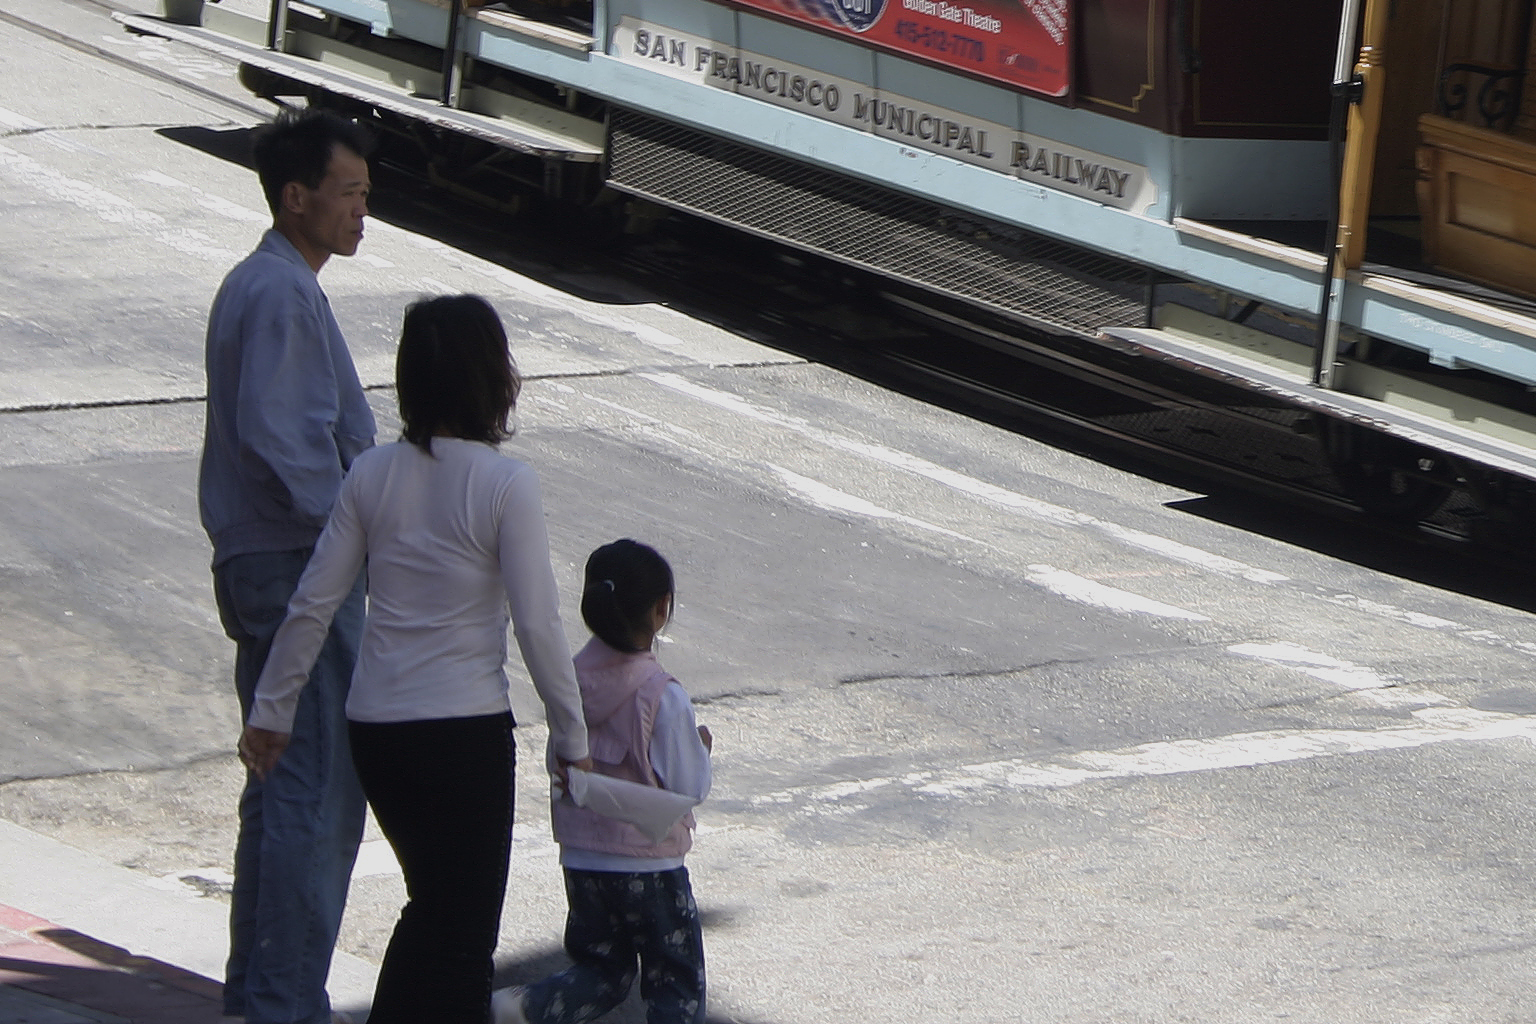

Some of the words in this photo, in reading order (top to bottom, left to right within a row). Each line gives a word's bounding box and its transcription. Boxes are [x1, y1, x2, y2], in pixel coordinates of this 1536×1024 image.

[936, 1, 963, 23] Gate
[962, 8, 1002, 34] Theatre
[633, 29, 686, 66] SAN
[694, 46, 840, 112] FRANCISCO
[852, 93, 994, 159] MUNICIPAL
[1010, 140, 1131, 198] RAILWAY
